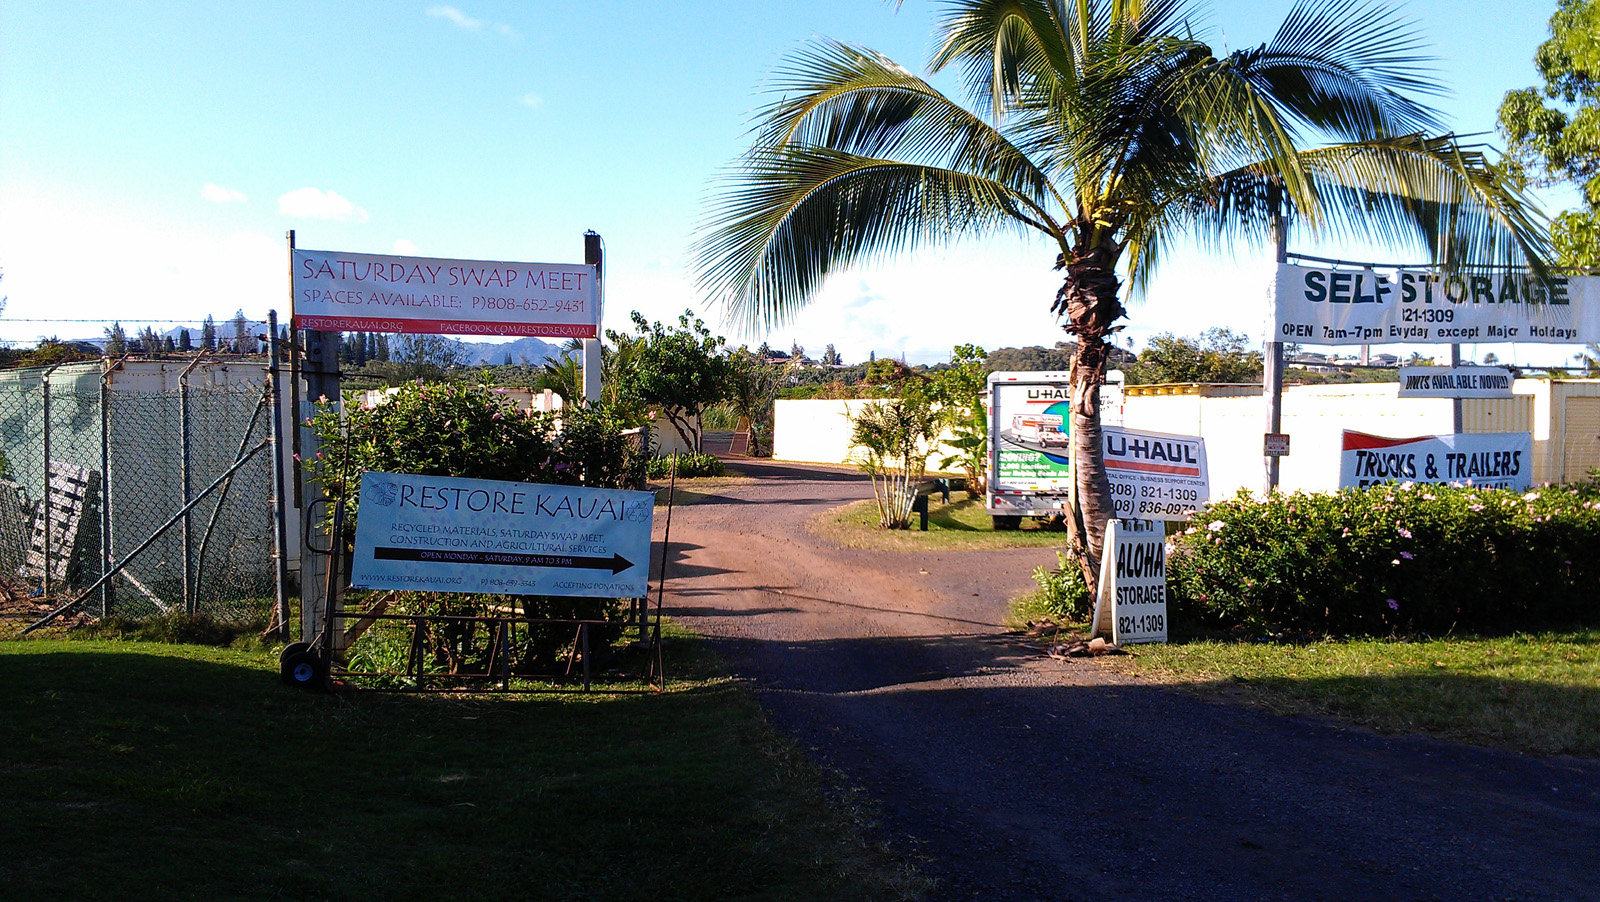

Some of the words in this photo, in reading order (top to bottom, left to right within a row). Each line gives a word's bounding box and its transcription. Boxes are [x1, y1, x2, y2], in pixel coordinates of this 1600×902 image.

[303, 259, 441, 284] SATURDAY
[448, 266, 518, 288] SWAP
[525, 270, 588, 291] MEET
[1304, 271, 1392, 304] SELF
[1402, 273, 1570, 305] STORAGE
[303, 289, 363, 304] SPACES
[367, 292, 462, 309] AVAILABLE:
[472, 296, 585, 313] P)808-652-9431
[1402, 308, 1454, 323] 21-1309
[301, 318, 404, 330] RESTOREKAUAI.ORG
[440, 323, 590, 336] FACEBOOK.COM/RESTOREKAUAI
[1282, 323, 1313, 337] OPEN
[1437, 325, 1480, 339] except
[1431, 374, 1478, 390] AVAILABLE
[1479, 375, 1509, 389] NOW!!!
[1028, 389, 1070, 399] U-HA
[1107, 436, 1197, 464] U-HAUL
[1355, 450, 1417, 479] TRUCKS
[1424, 453, 1439, 480] &
[1446, 450, 1522, 479] TRAILERS
[400, 484, 526, 515] RESTORE
[535, 494, 625, 521] KAUAI
[1141, 486, 1198, 501] 821-1309
[391, 522, 440, 533] RECYCLED
[442, 525, 498, 538] MATERIALS,
[500, 528, 550, 540] SATURDAY
[551, 531, 578, 541] SWAP
[580, 533, 605, 543] MEET,
[389, 534, 468, 547] CONSTRUCTION
[470, 539, 494, 549] AND
[494, 540, 565, 552] AGRICULTURAL
[568, 544, 607, 554] SERVICES
[420, 551, 442, 559] OPEN
[443, 552, 478, 560] MONDAY
[561, 557, 573, 565] PM
[1117, 543, 1163, 578] ALOHA
[360, 574, 462, 585] WWW.RESTOREKAUAI.ORG
[553, 581, 592, 590] ACCEPTING
[593, 582, 635, 592] DONATIONS
[1116, 585, 1164, 605] STORAGE
[1118, 615, 1164, 634] 821-1309
